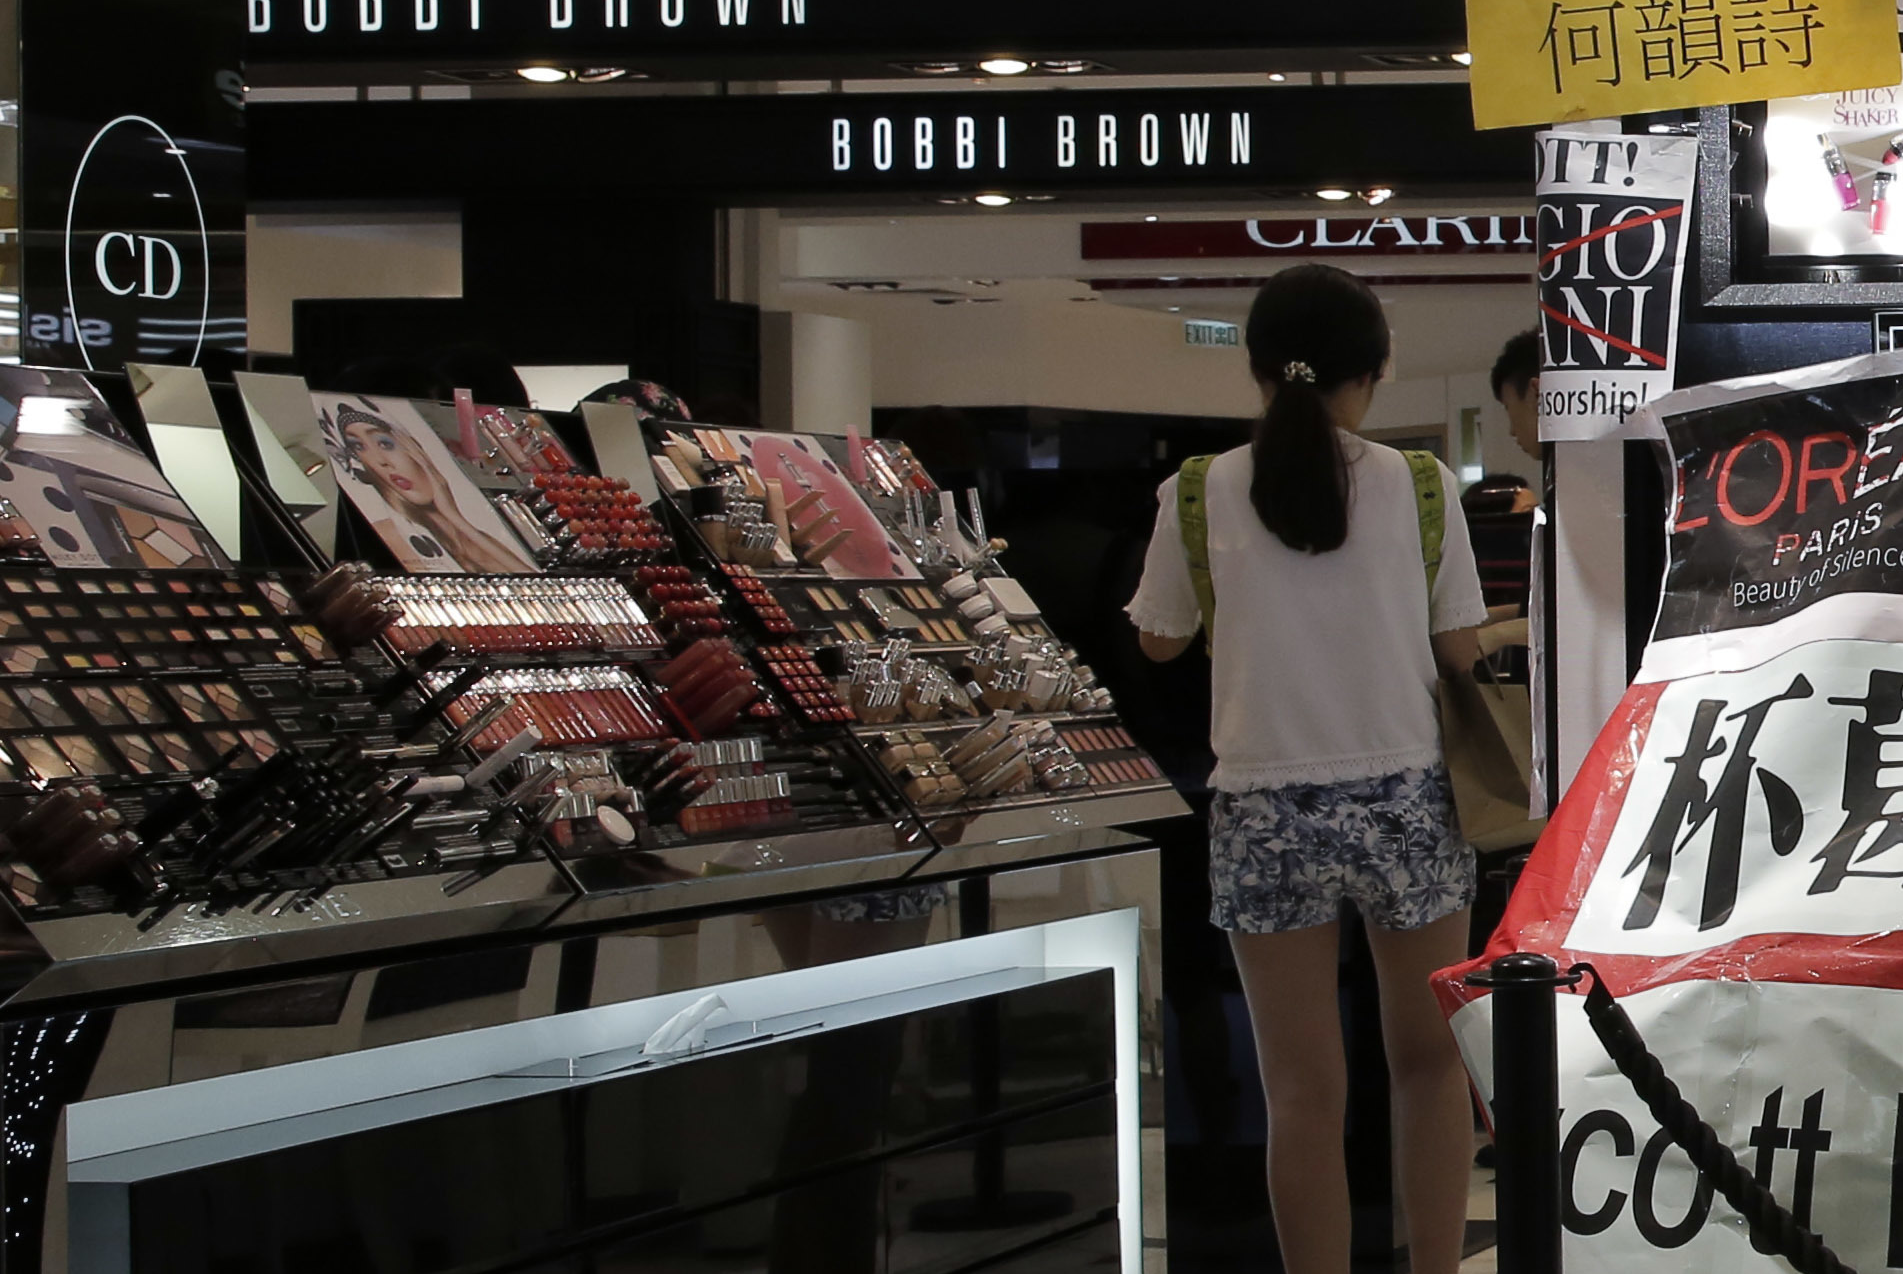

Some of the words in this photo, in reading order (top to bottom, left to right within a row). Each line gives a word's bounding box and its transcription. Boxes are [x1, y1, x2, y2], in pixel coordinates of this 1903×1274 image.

[1836, 88, 1900, 107] JUICY
[831, 115, 1007, 172] BOBBI
[1057, 111, 1252, 168] BROWN
[95, 230, 183, 301] CD
[1734, 577, 1806, 609] Beauty
[1807, 557, 1830, 588] of
[1556, 1086, 1833, 1261] cott
